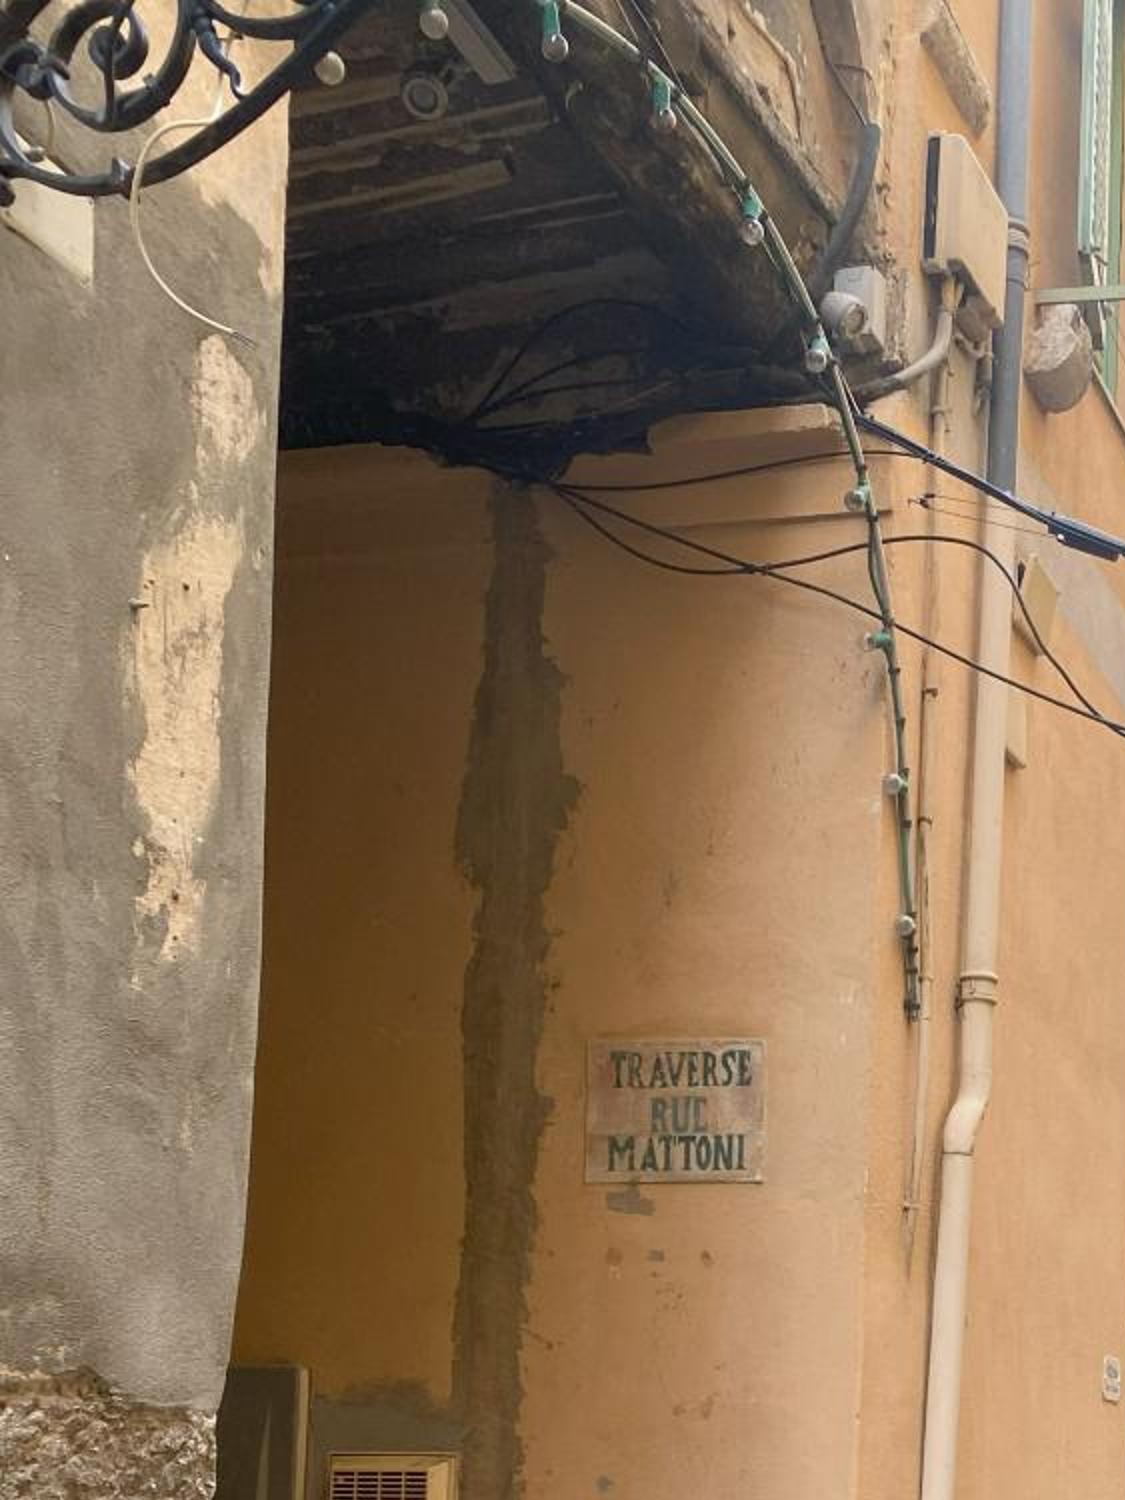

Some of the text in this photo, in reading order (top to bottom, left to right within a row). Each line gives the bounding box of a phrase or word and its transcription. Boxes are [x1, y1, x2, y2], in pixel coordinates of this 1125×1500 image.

[610, 1049, 753, 1089] TRAVERSE
[651, 1095, 708, 1134] RUE
[607, 1134, 748, 1172] MATTONI
